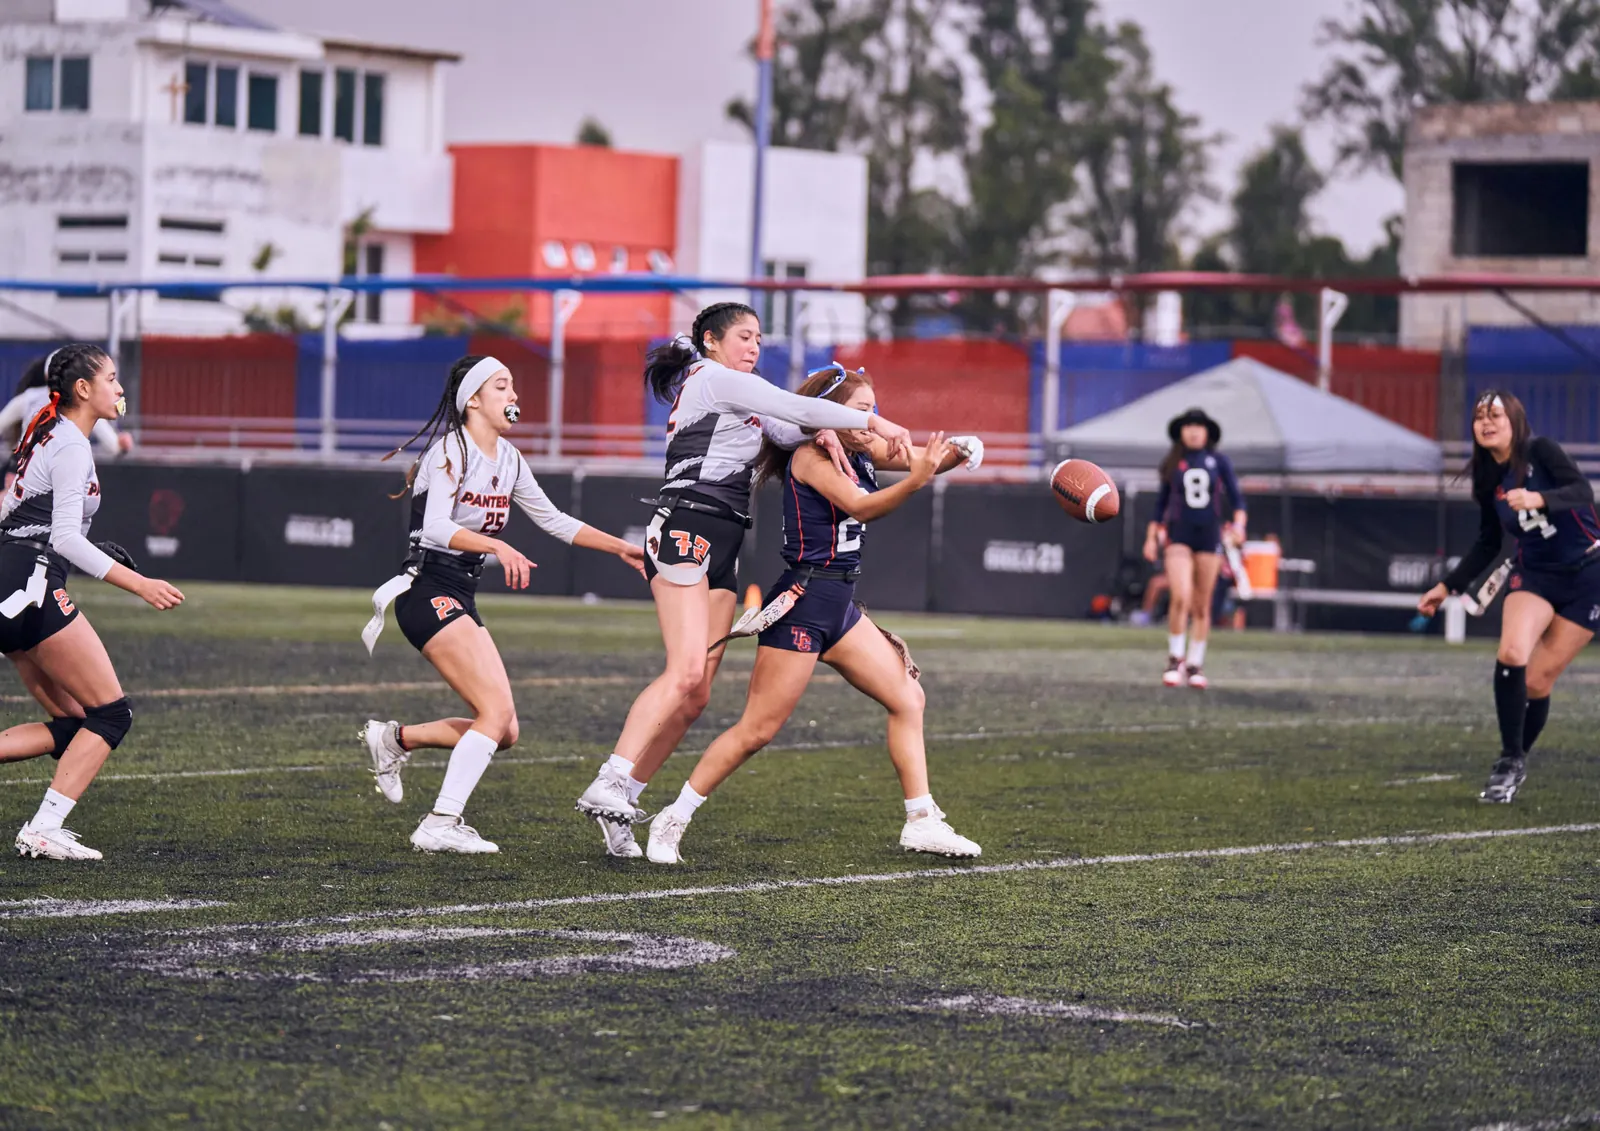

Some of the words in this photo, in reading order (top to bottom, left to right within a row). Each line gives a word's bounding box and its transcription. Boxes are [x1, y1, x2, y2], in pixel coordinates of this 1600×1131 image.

[1183, 467, 1211, 509] 8
[479, 511, 505, 534] 25
[1518, 508, 1557, 540] 4
[669, 529, 712, 564] 72
[791, 625, 812, 652] TC
